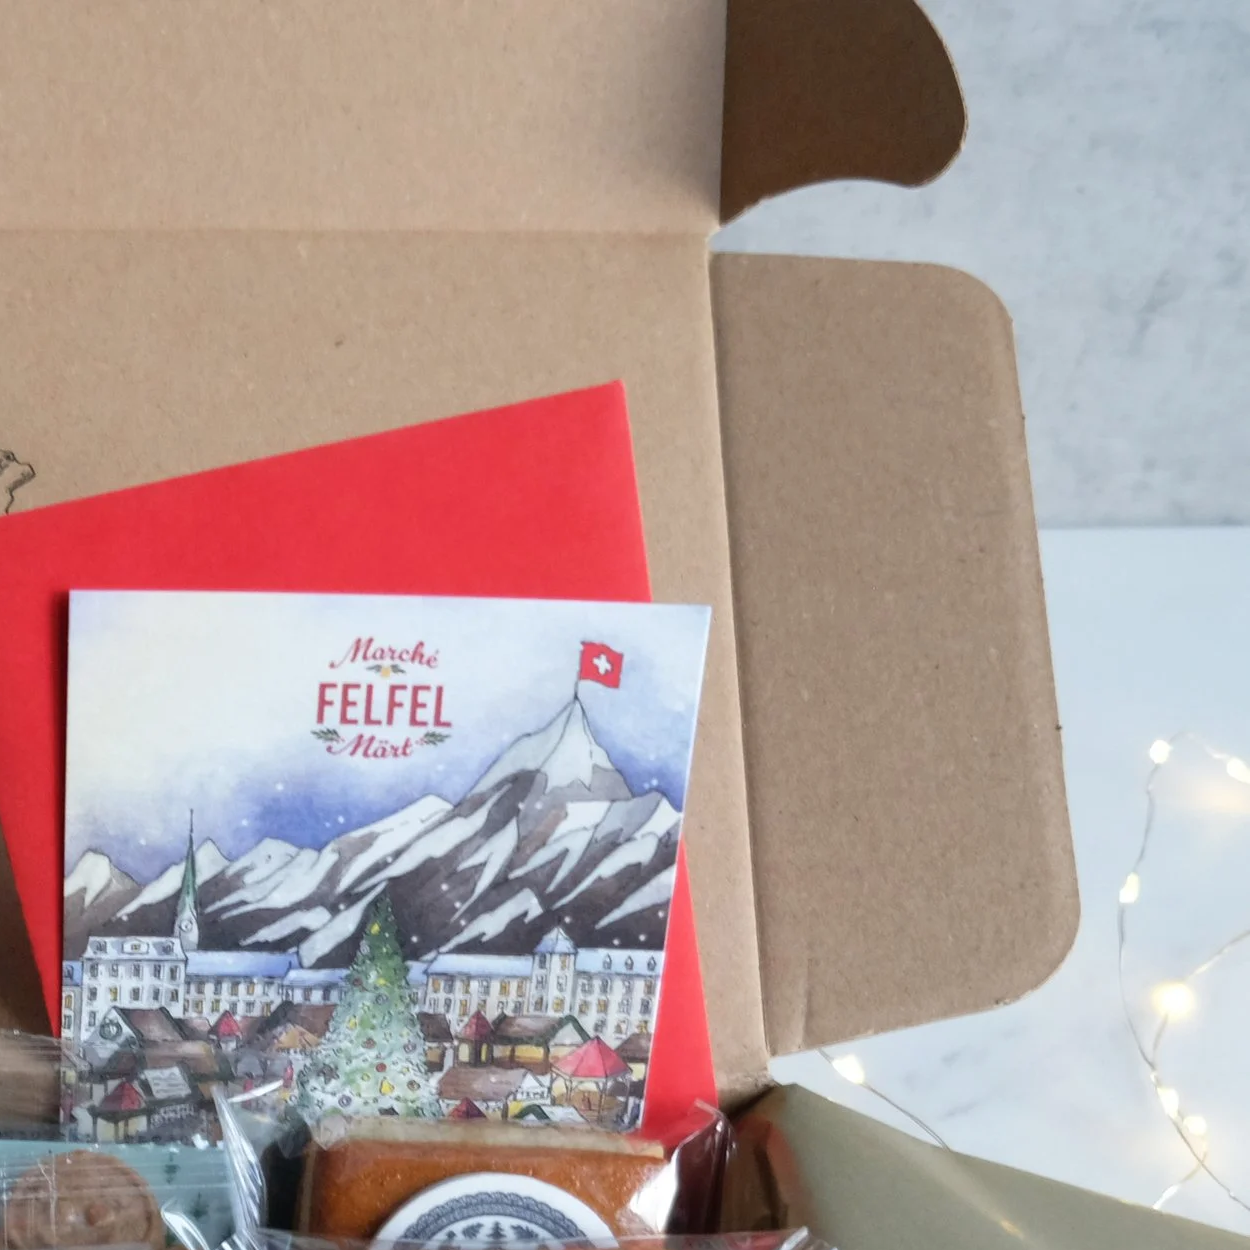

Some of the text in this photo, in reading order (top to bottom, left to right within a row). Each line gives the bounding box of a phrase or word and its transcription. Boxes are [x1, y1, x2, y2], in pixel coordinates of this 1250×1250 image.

[328, 636, 440, 669] Marché
[316, 682, 453, 727] FELFEL
[326, 733, 414, 759] Märt
